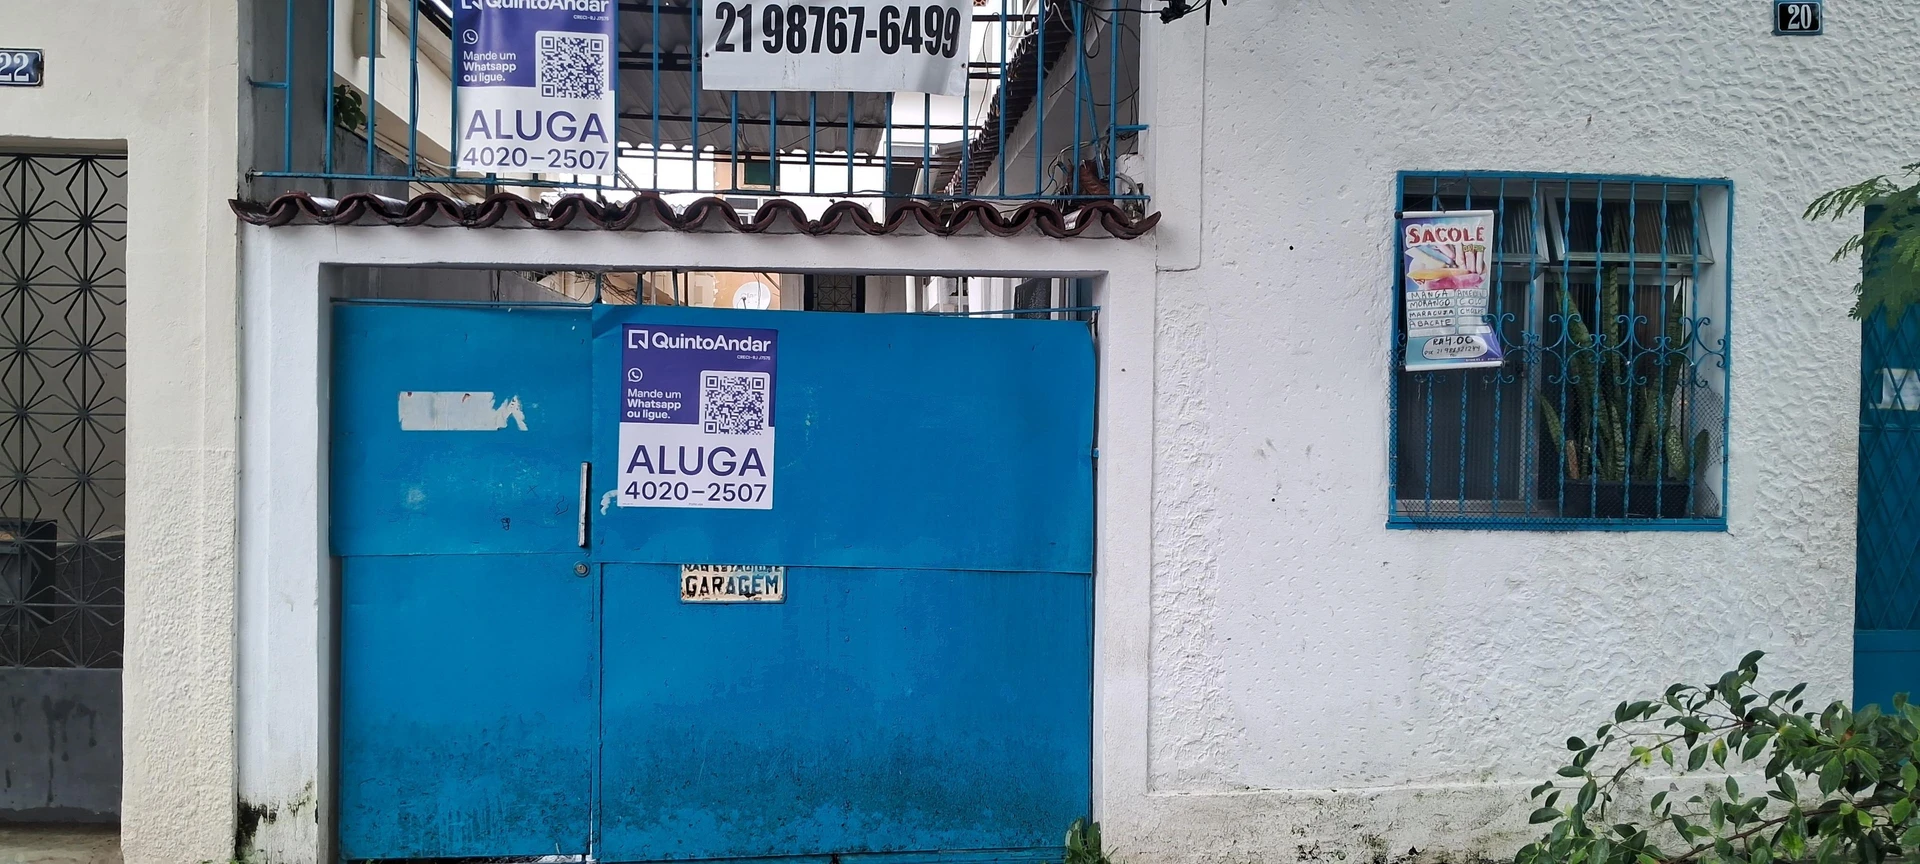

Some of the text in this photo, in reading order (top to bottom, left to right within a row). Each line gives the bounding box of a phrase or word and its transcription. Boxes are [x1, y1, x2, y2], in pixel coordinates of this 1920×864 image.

[1787, 4, 1812, 29] 20
[715, 1, 961, 58] 21 98767-6499
[0, 52, 29, 82] 22
[463, 51, 517, 61] Mande um
[463, 61, 517, 73] Whatsapp
[463, 72, 506, 84] ou ligue.
[464, 108, 609, 144] ALUGA
[462, 146, 610, 170] 4020-2507
[652, 332, 771, 352] QuintoAndar
[627, 388, 682, 399] Mande um
[627, 399, 682, 411] Whatsapp
[627, 409, 671, 421] ou ligue.
[626, 444, 767, 477] ALUGA
[624, 481, 767, 503] 4020-2507
[685, 575, 779, 597] GARAGEM
